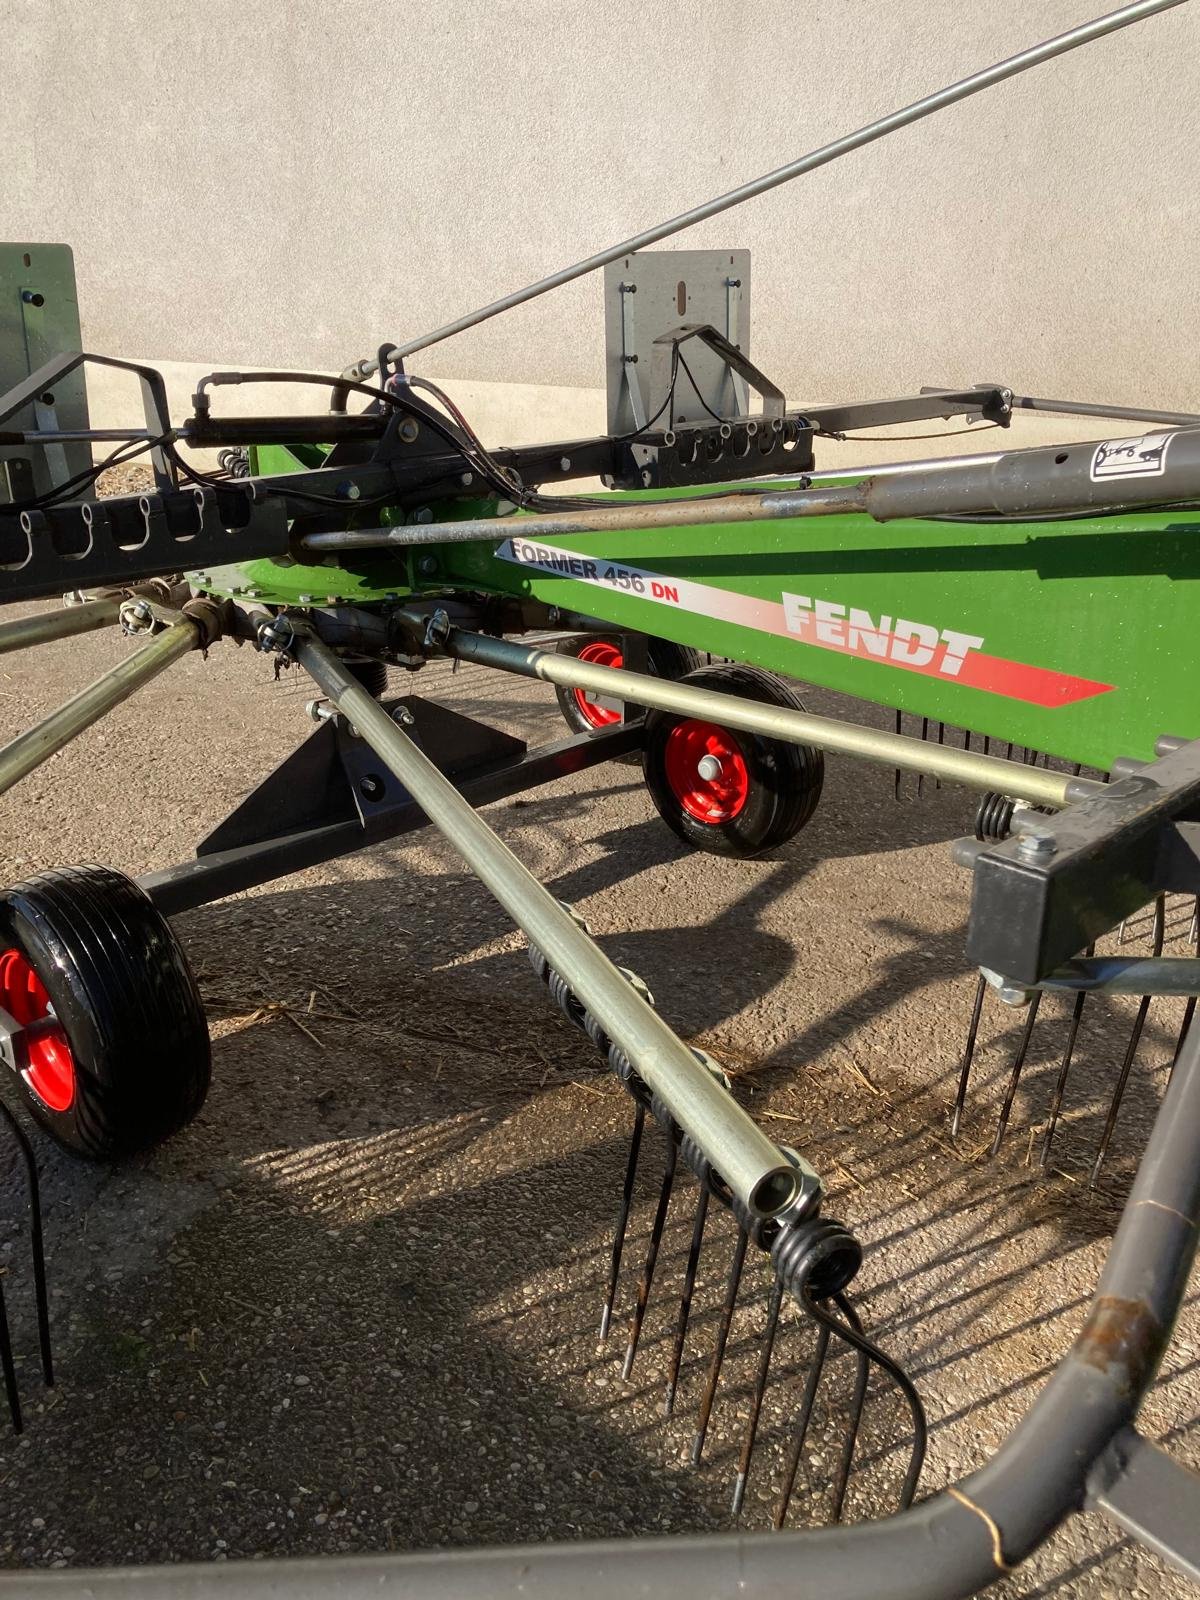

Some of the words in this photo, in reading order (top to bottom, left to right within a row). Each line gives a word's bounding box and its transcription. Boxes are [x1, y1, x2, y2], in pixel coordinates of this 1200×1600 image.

[509, 540, 599, 582] FORMER
[603, 567, 646, 594] 456
[651, 582, 680, 604] DN
[781, 591, 985, 676] FENDT
